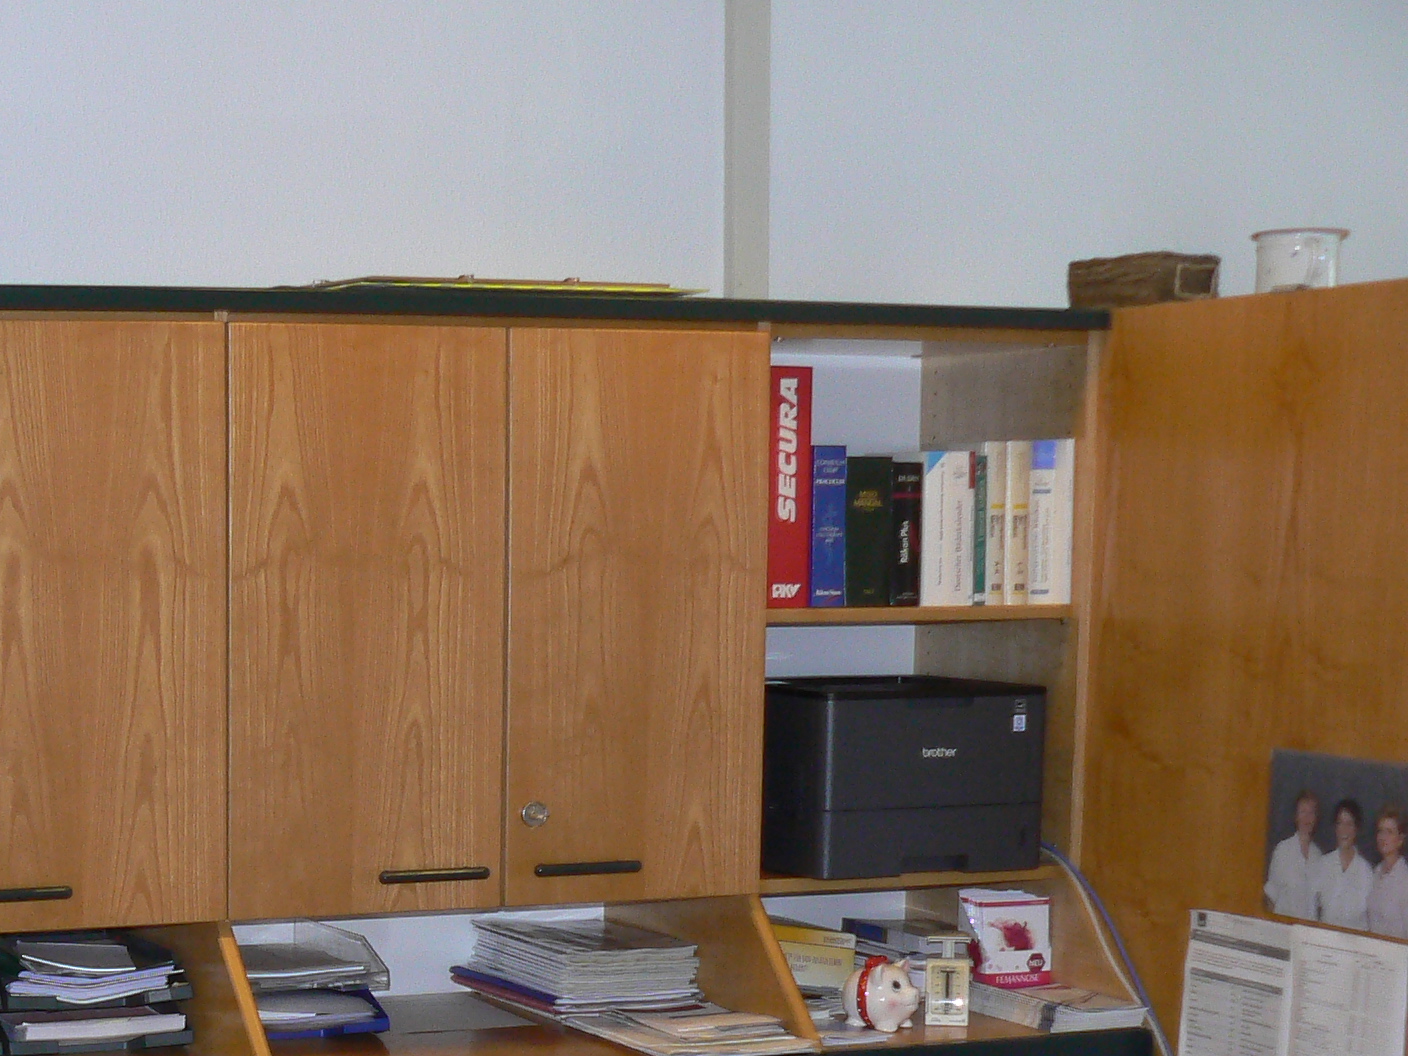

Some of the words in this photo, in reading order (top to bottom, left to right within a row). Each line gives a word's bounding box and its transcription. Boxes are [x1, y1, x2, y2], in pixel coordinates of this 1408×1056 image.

[777, 377, 800, 523] SECURA
[900, 520, 910, 537] Plus
[771, 583, 801, 599] DKV
[922, 747, 957, 758] brother
